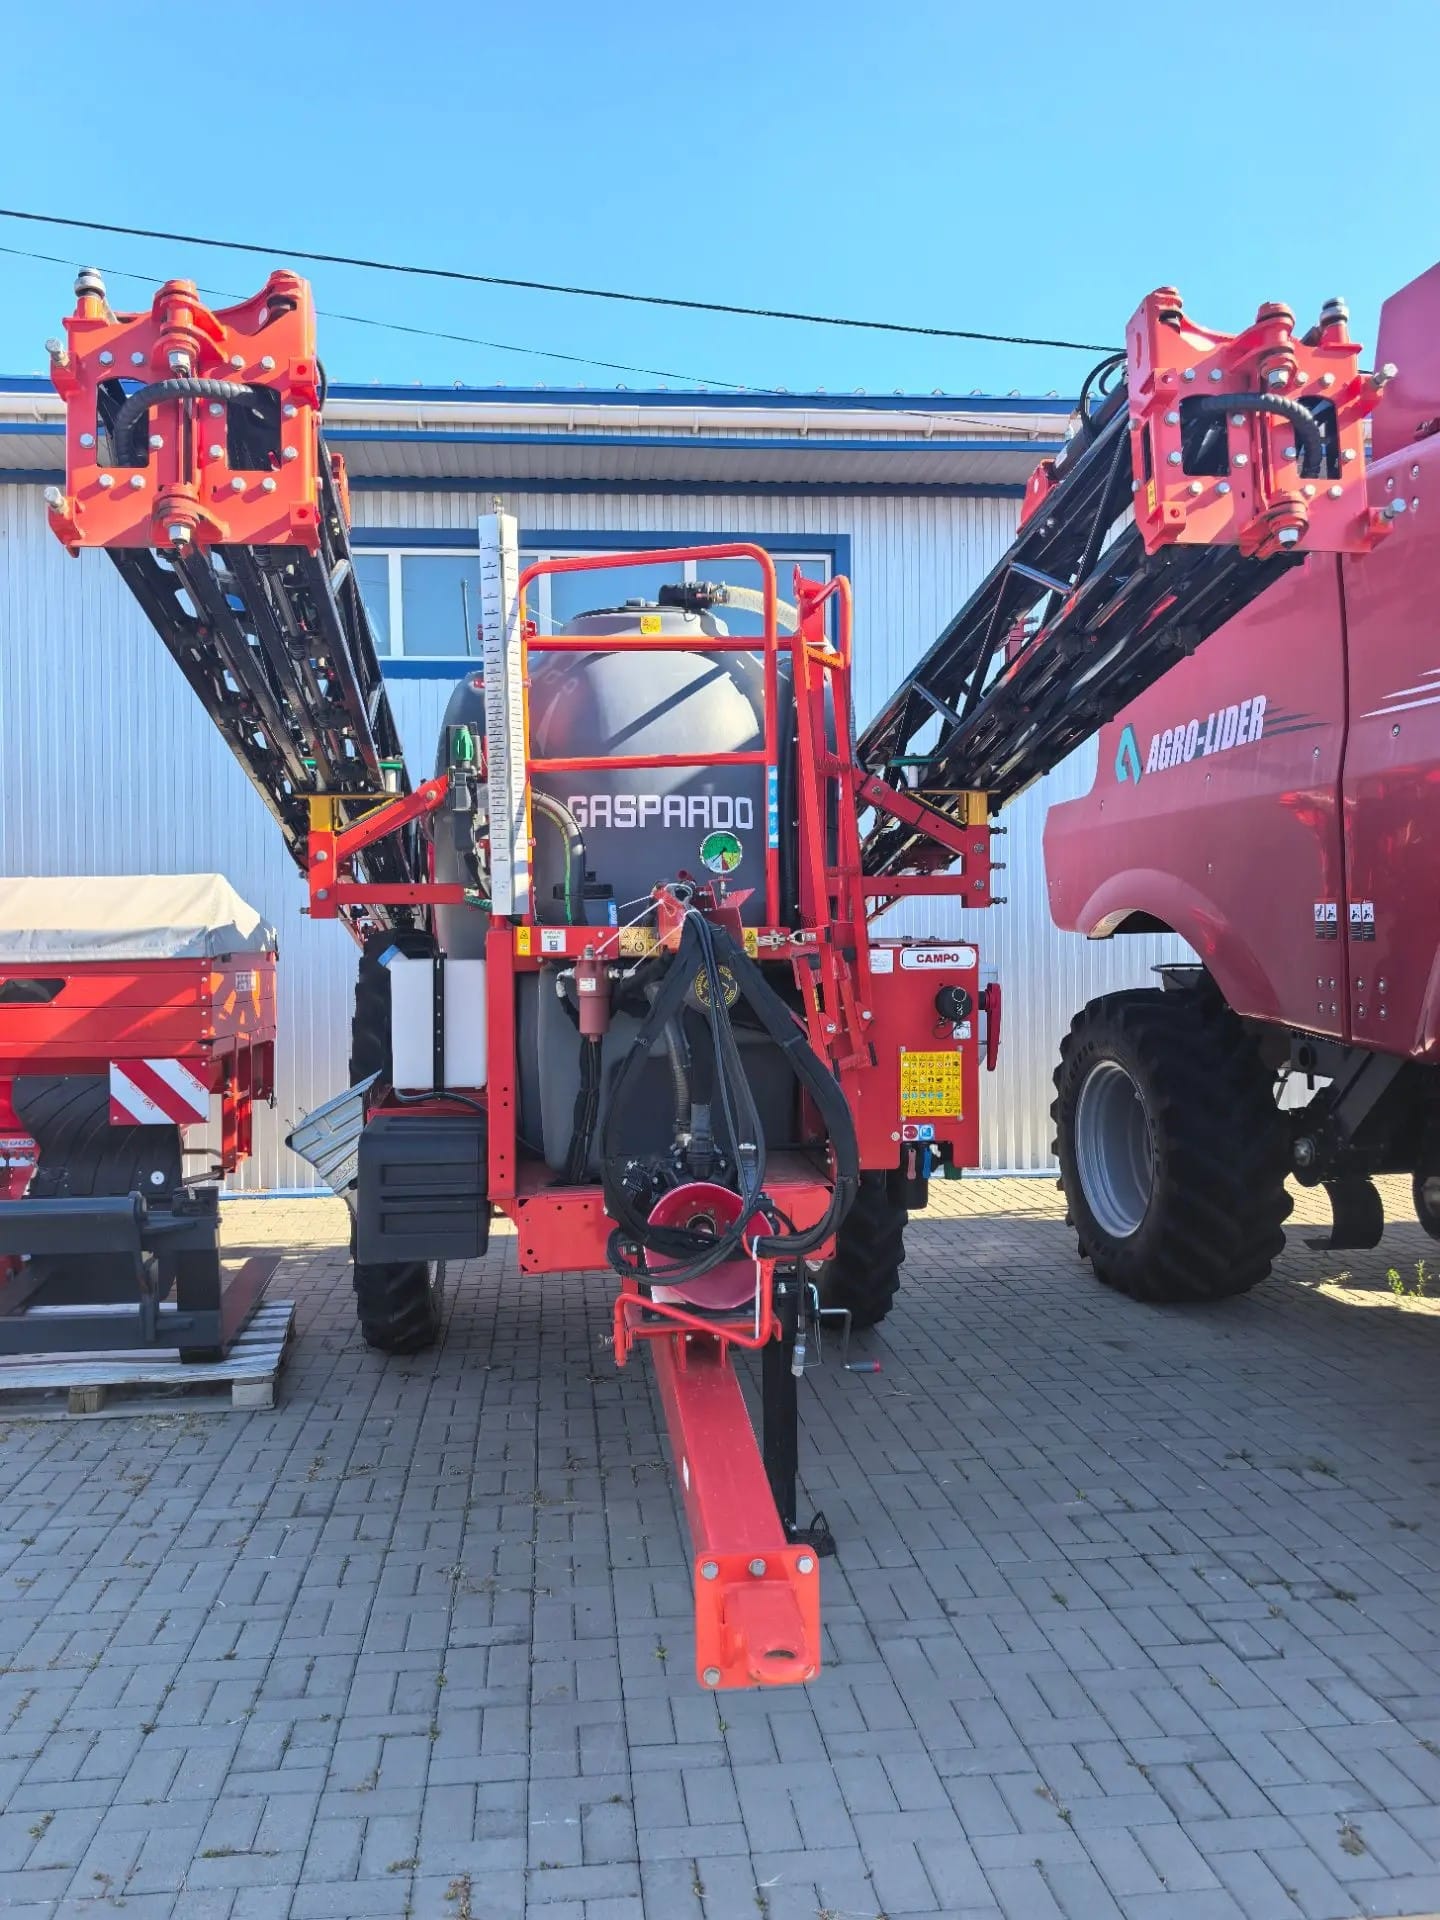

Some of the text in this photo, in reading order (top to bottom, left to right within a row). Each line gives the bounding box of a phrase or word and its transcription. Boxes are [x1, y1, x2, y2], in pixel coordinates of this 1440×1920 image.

[1145, 694, 1267, 775] AGRO-LIDER
[567, 794, 754, 830] GASPARDO
[916, 953, 960, 964] CAMPO
